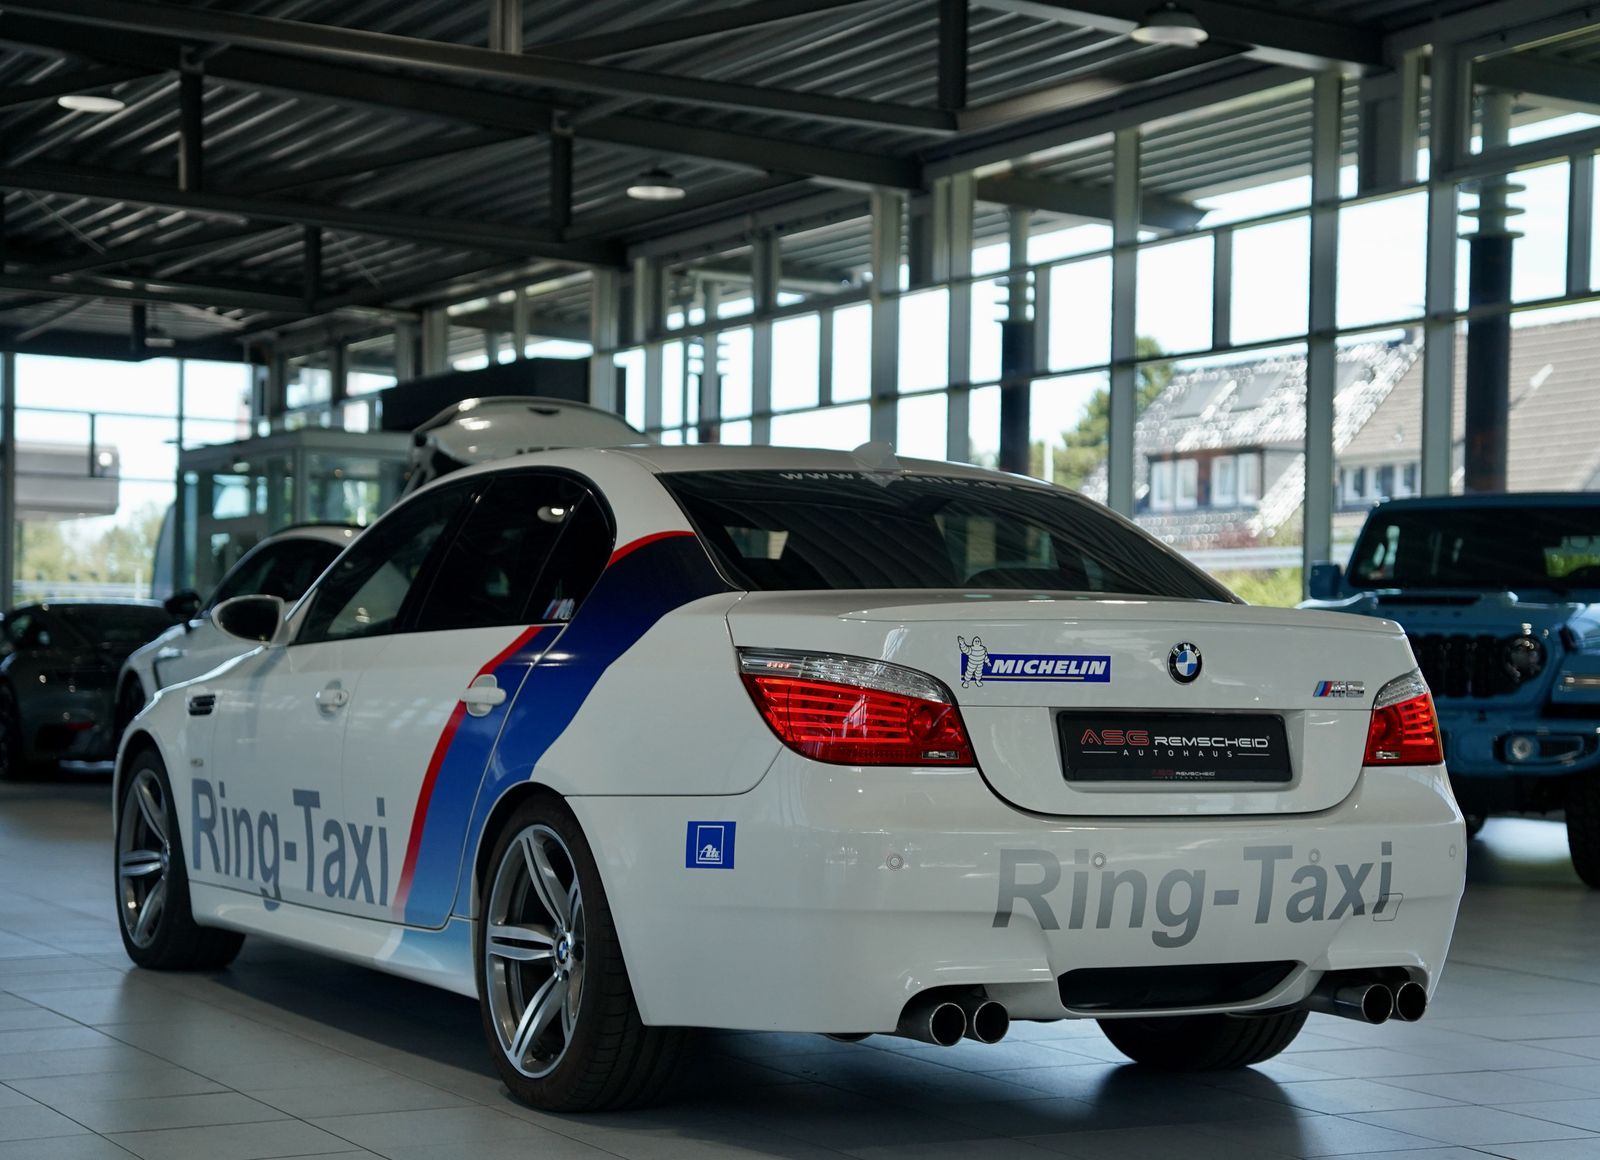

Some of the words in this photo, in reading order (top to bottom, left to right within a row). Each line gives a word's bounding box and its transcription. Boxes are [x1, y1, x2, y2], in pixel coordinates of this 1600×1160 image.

[991, 659, 1107, 675] MICHELIN
[1081, 728, 1150, 746] ASG
[1154, 736, 1269, 748] REMSCHEID
[1123, 749, 1233, 758] AUTOHAUS
[191, 778, 389, 912] Ring-Taxi
[992, 841, 1393, 948] Ring-Taxi
